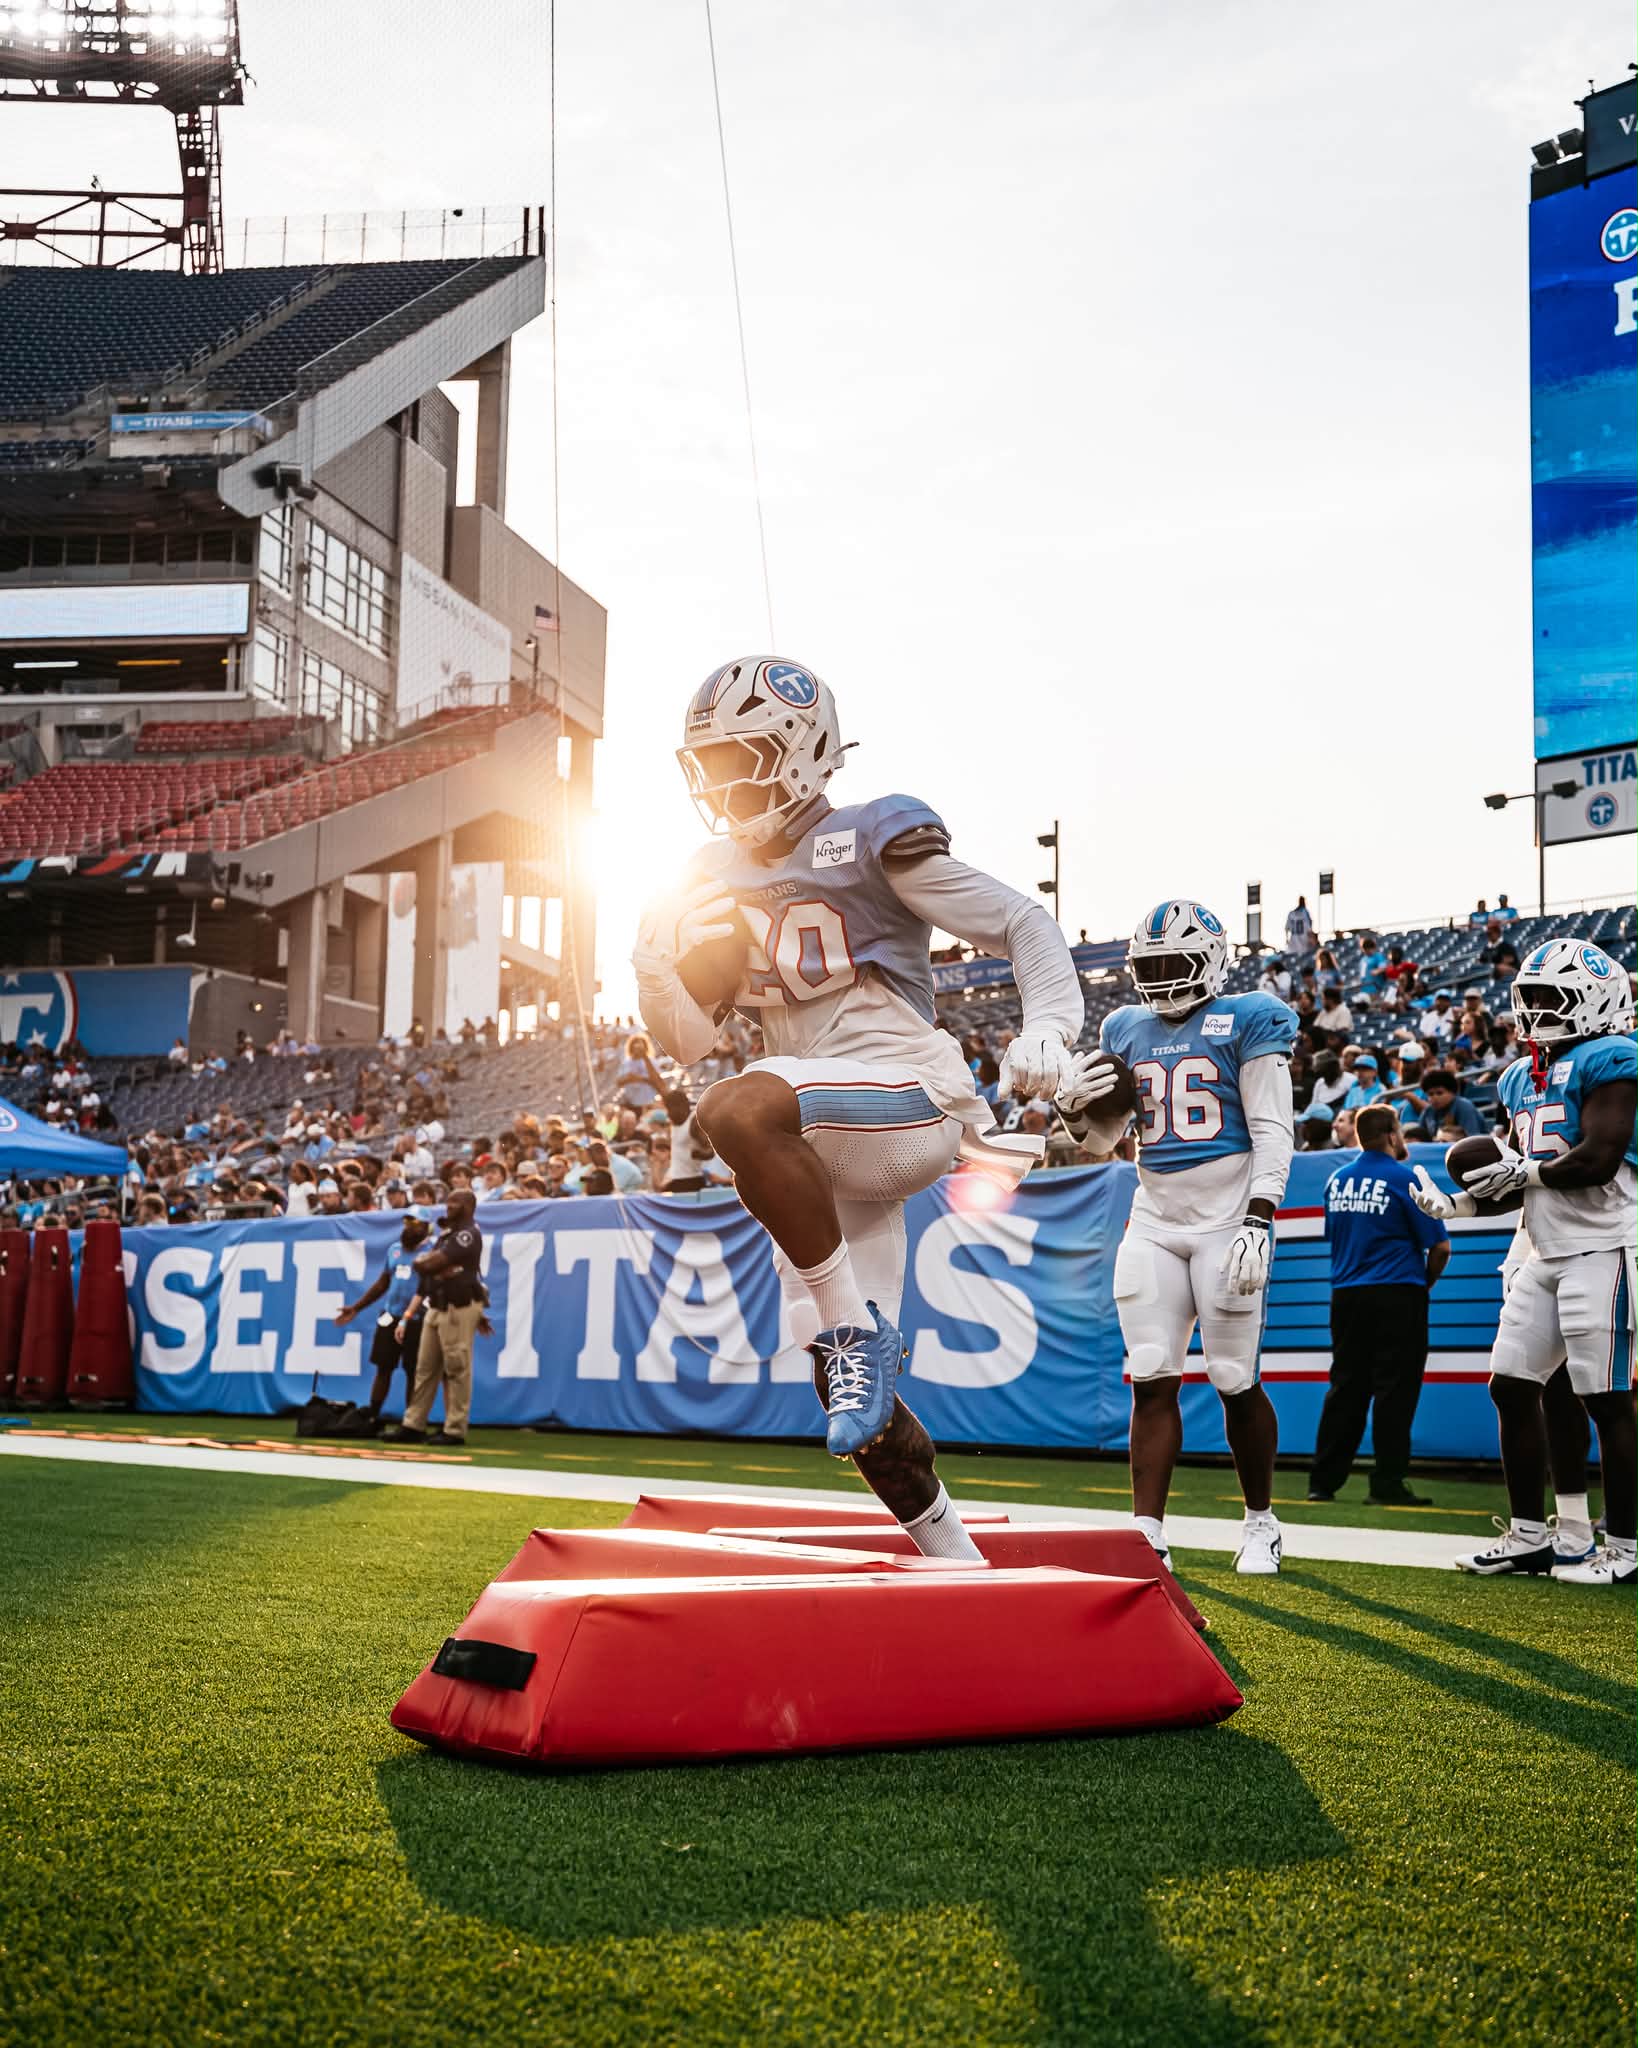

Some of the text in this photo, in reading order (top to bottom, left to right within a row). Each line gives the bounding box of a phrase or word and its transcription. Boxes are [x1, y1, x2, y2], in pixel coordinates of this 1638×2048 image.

[1618, 113, 1638, 135] V
[816, 840, 853, 862] Kroger
[735, 900, 857, 1006] 20
[1204, 1017, 1231, 1033] Kroger
[1151, 1043, 1191, 1055] TITANS
[1132, 1056, 1223, 1146] 36
[1329, 1177, 1390, 1204] S.A.F.E.
[1329, 1200, 1388, 1215] SECURITY
[122, 1239, 366, 1376] SEE
